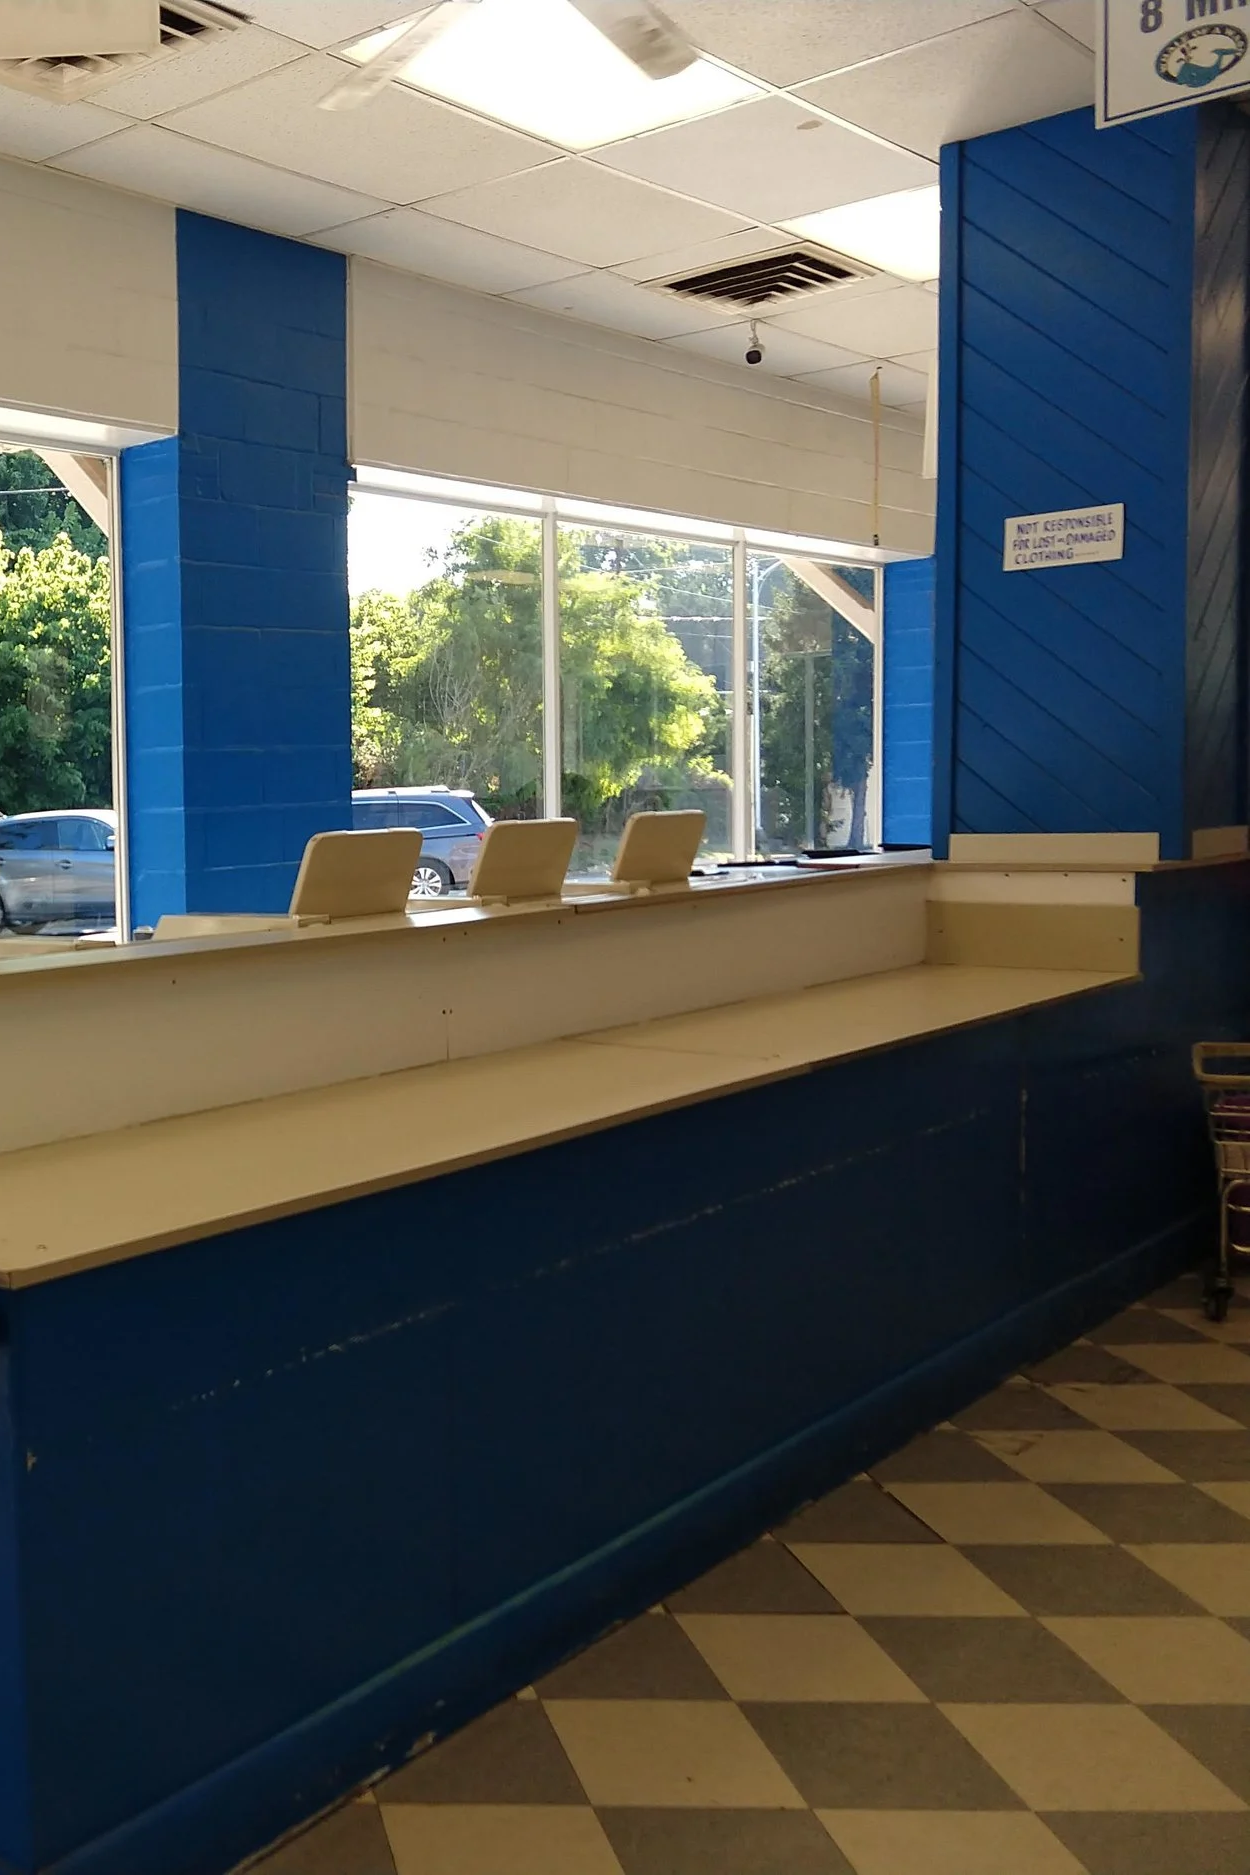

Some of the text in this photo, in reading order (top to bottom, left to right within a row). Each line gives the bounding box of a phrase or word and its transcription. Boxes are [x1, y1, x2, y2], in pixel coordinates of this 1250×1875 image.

[1140, 0, 1162, 33] 8
[1017, 512, 1114, 535] NOT RESPONSIBLE
[1013, 538, 1030, 551] FOR
[1033, 536, 1056, 549] LOST
[1066, 529, 1116, 546] DAMAGED
[1015, 548, 1074, 565] CLOTHING
